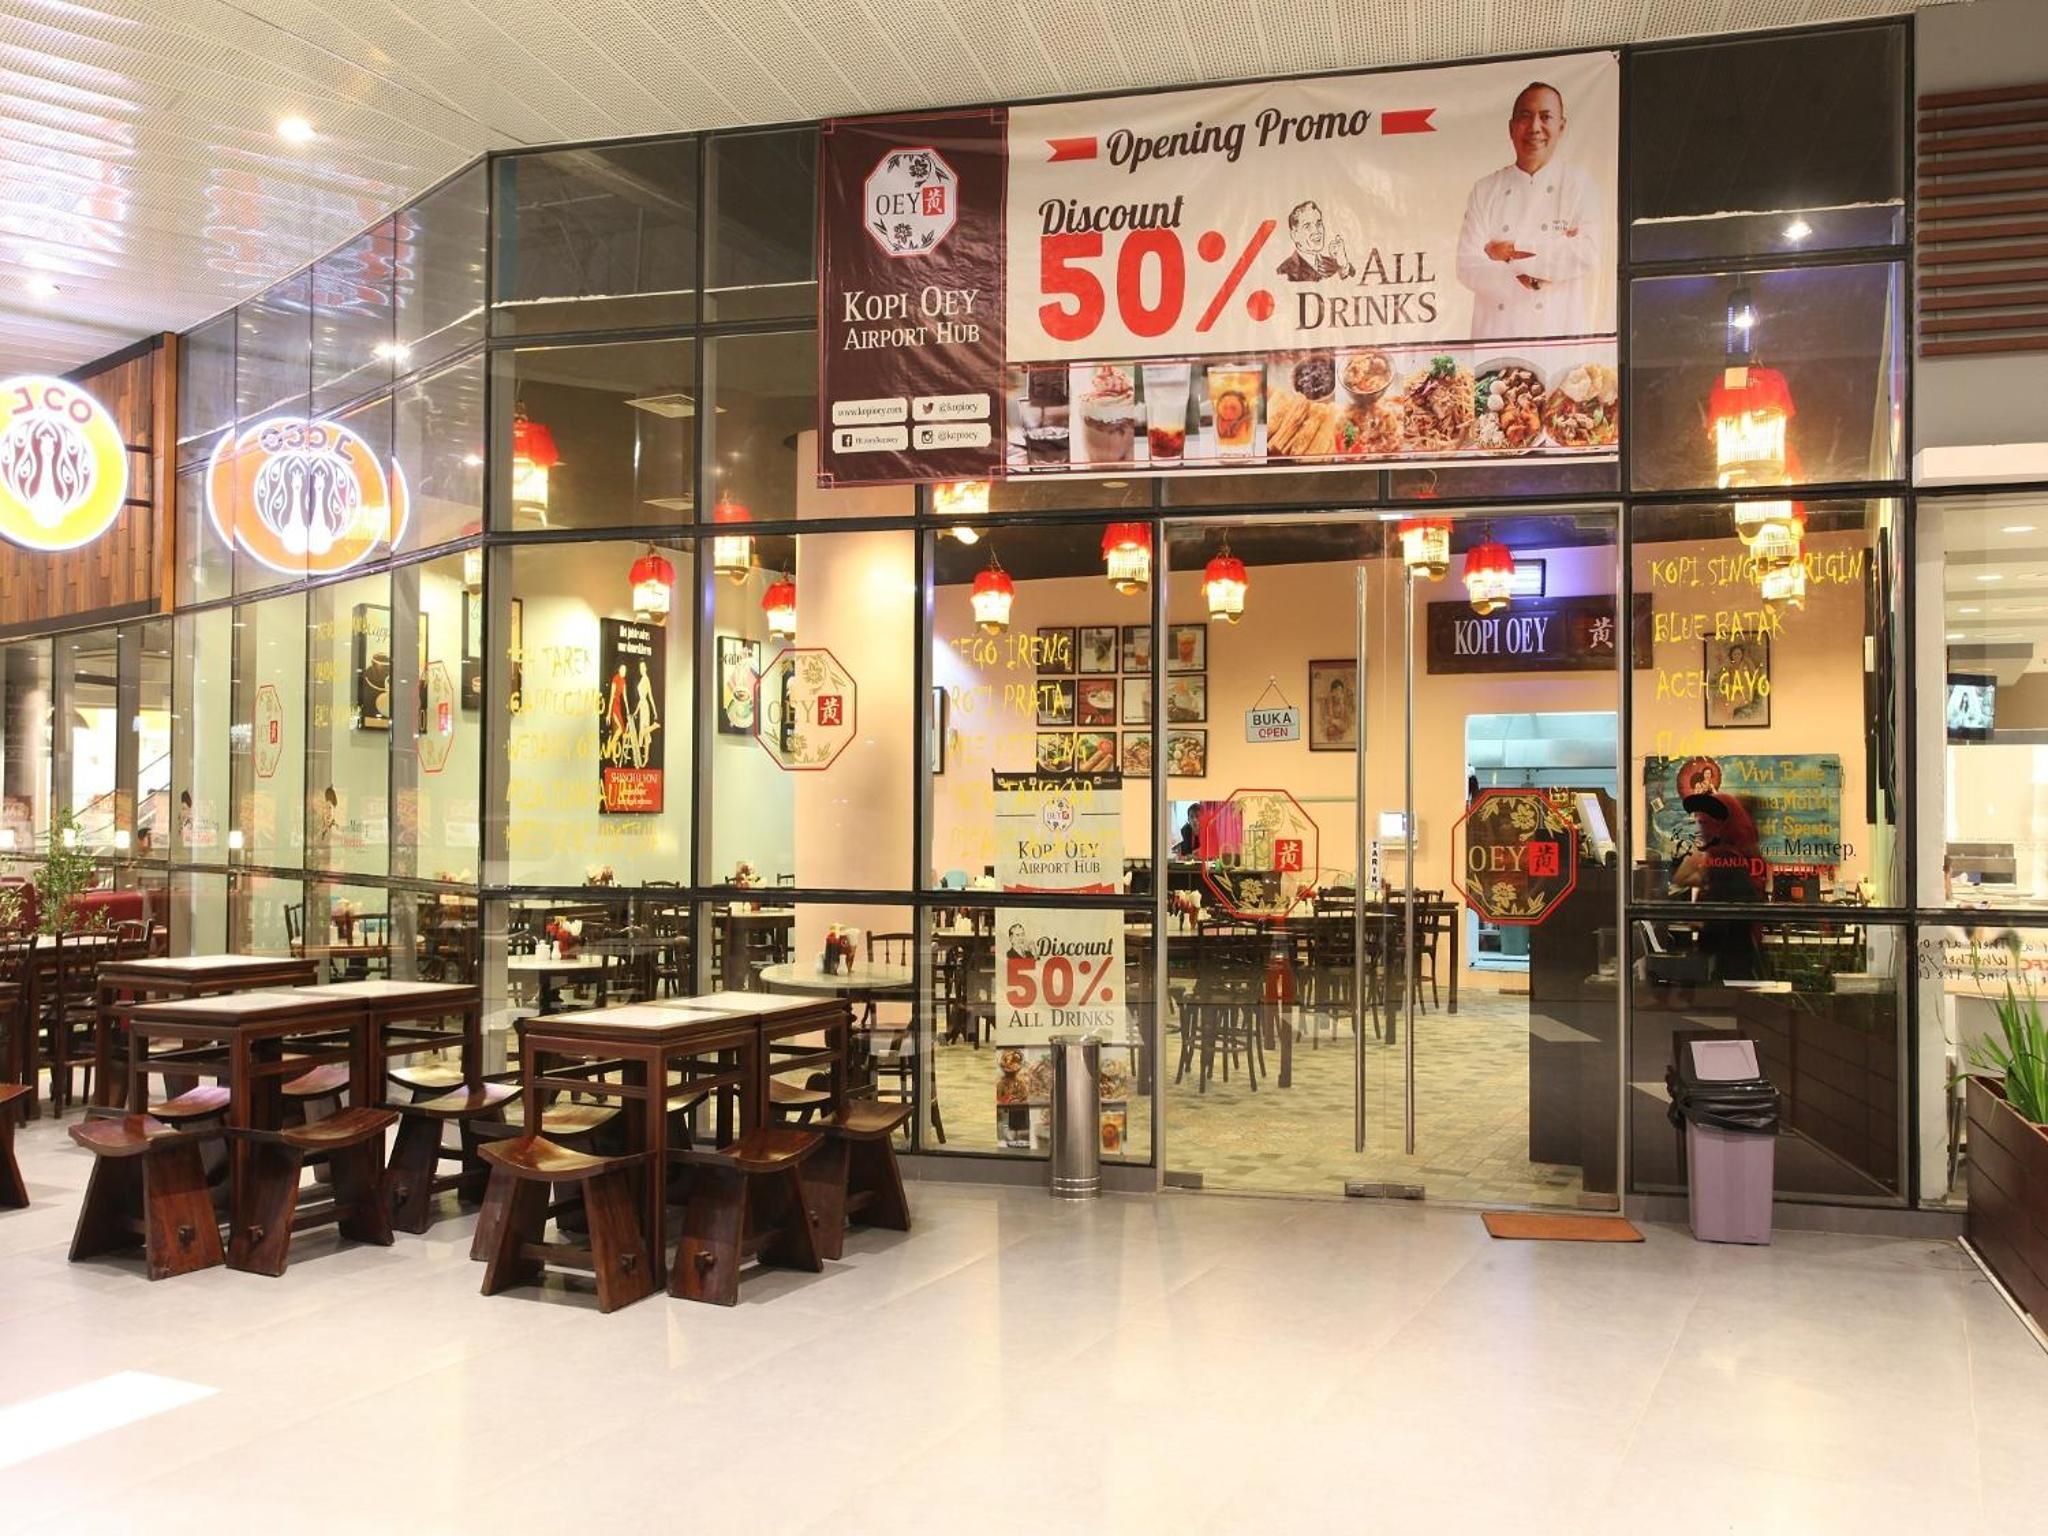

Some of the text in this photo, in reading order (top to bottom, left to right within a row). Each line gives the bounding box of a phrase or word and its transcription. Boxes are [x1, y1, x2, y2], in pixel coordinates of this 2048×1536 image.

[1106, 107, 1372, 174] Opening Promo
[876, 191, 920, 216] OEY
[1038, 195, 1184, 237] Discount
[1038, 219, 1278, 342] 50%
[843, 286, 980, 322] KOPI OEY
[844, 321, 980, 350] AIRPORT HUB
[12, 386, 92, 424] J.CO
[1652, 555, 1703, 588] KOPI
[1453, 619, 1499, 655] KOPI
[1506, 616, 1549, 654] OEY
[1656, 667, 1771, 701] ACEH GAYO
[1252, 712, 1292, 726] BUKA
[1258, 727, 1289, 739] OPEN
[1370, 841, 1380, 884] TARIK
[1468, 845, 1528, 872] OEY
[1784, 838, 1857, 861] Mantep.
[1036, 935, 1114, 959] Discount
[1006, 955, 1114, 1009] 50%
